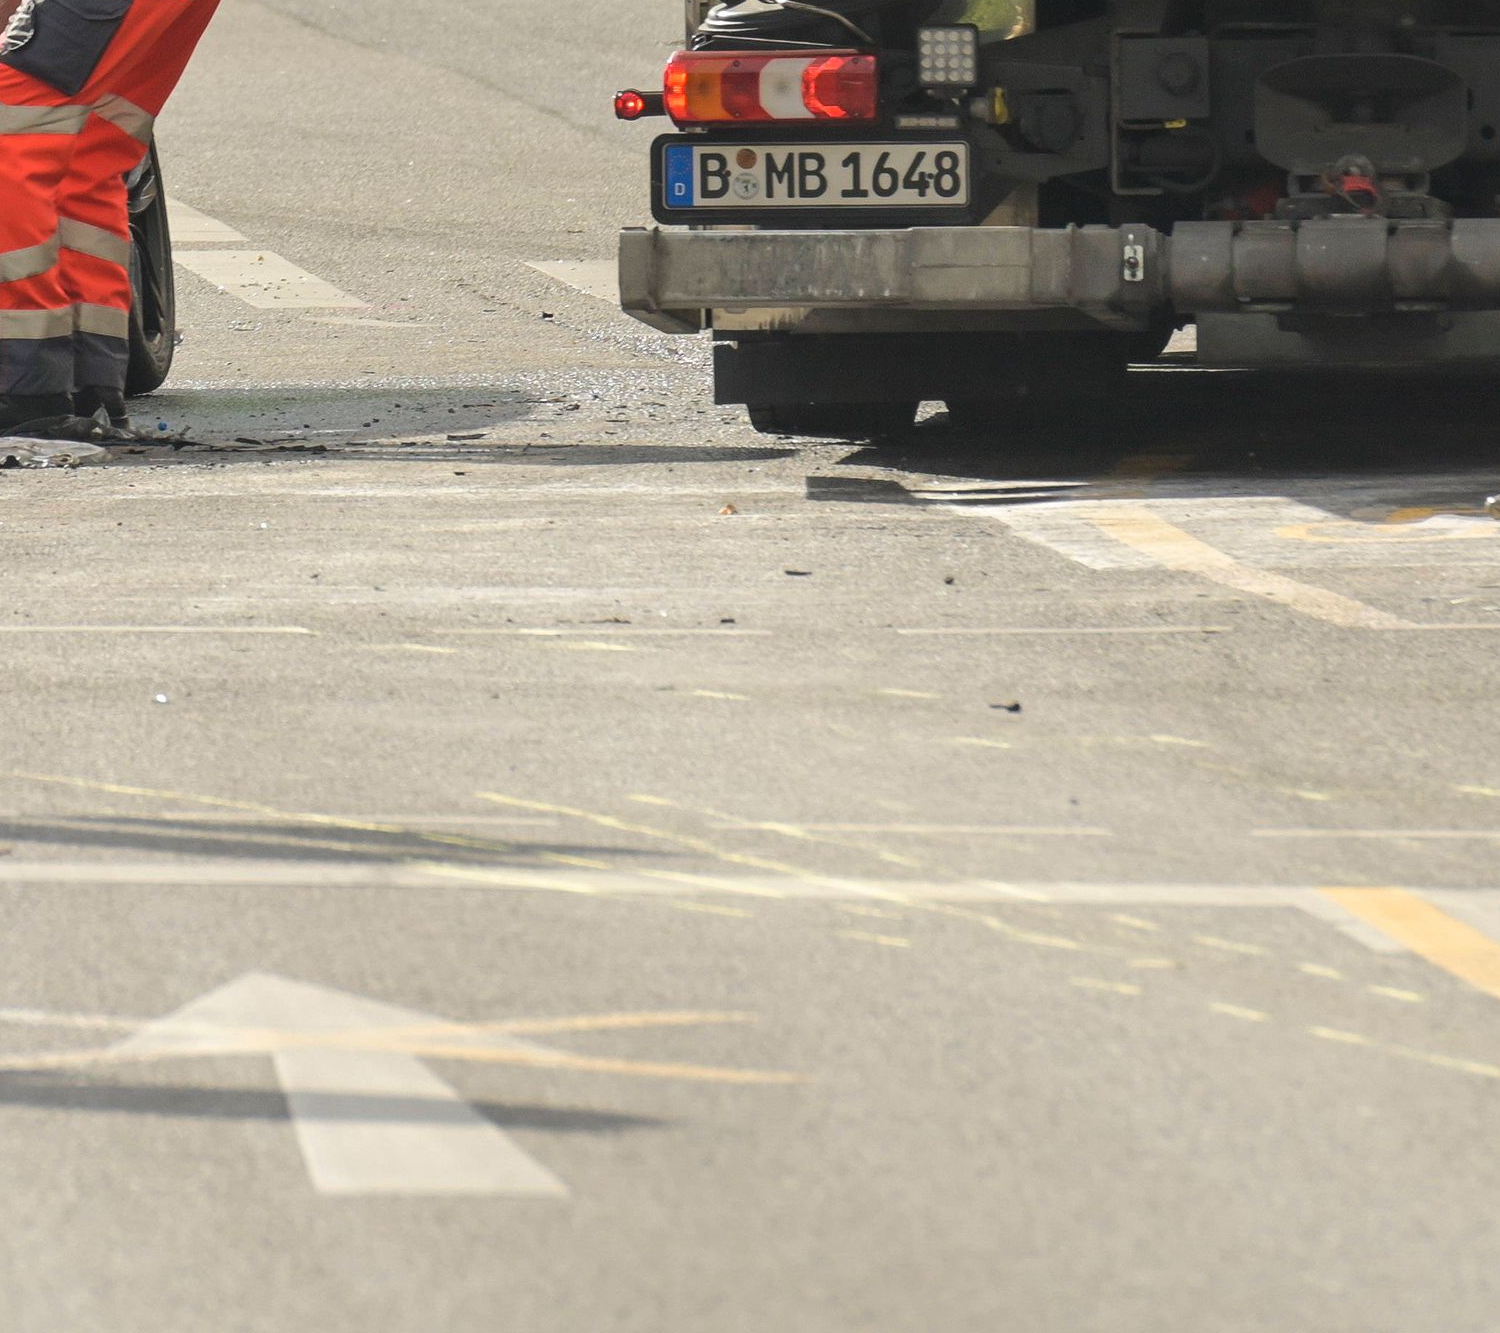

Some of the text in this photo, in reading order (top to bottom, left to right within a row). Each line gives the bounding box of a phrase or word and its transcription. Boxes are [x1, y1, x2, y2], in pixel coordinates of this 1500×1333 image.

[700, 152, 731, 199] B
[765, 151, 828, 199] MB
[840, 150, 961, 198] 1648
